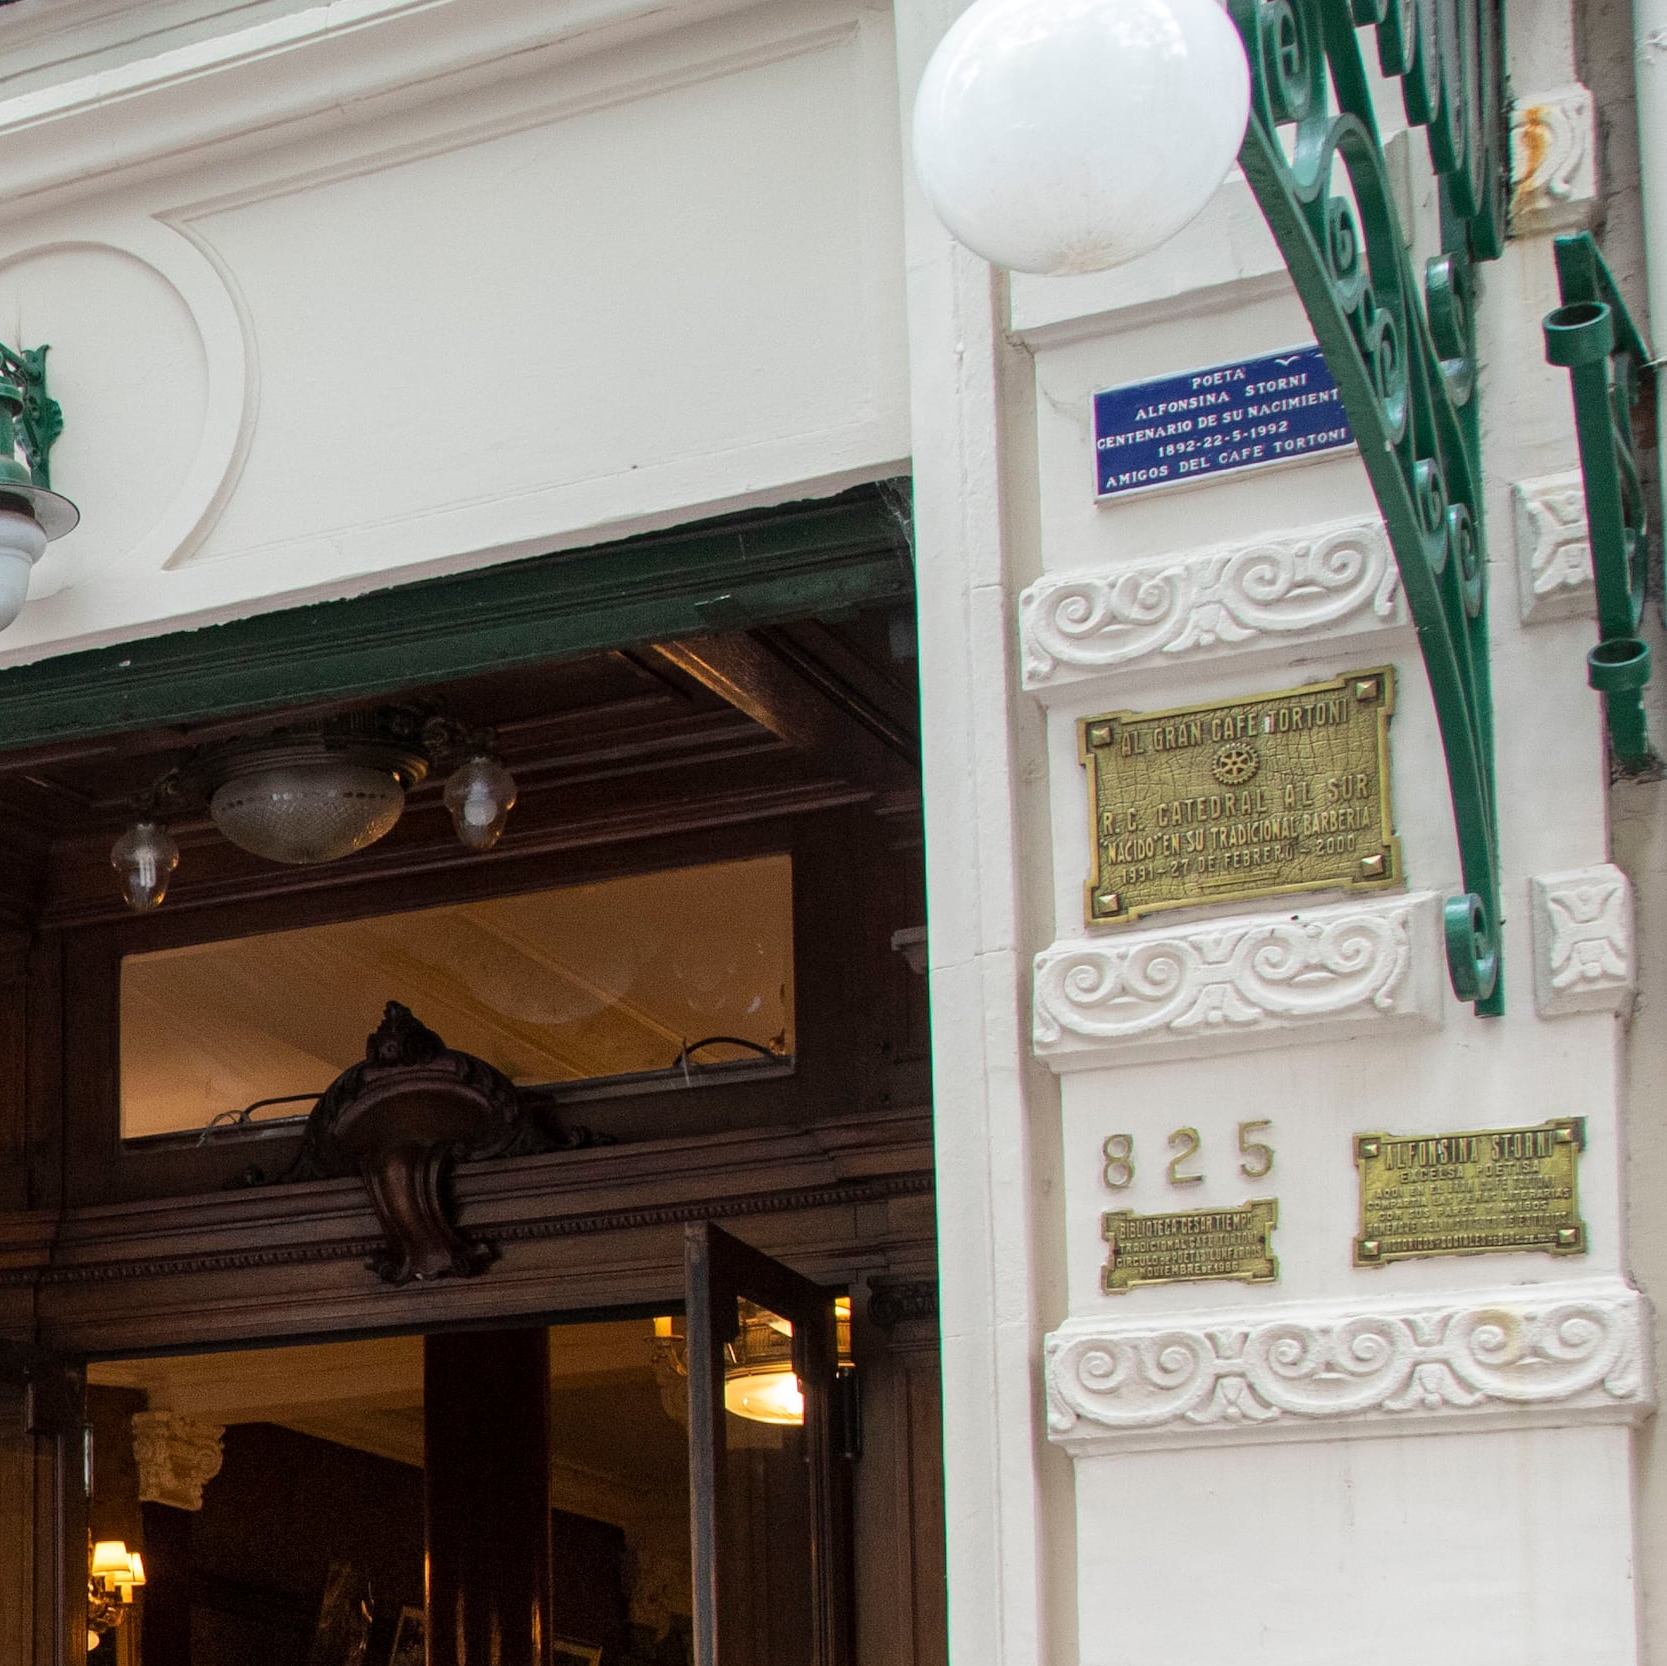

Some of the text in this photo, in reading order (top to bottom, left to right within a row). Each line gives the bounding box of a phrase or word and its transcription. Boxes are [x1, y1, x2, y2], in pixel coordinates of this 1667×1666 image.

[1135, 373, 1307, 421] ALFONSINA STORNI
[1192, 369, 1246, 389] POETA
[1097, 421, 1192, 450] CENTENARIO
[1198, 416, 1217, 428] DE
[1222, 409, 1242, 423] SU
[1106, 428, 1348, 488] AMIGOS DEL CAFE TORTONI
[1121, 699, 1348, 756] AL GRAN CAFE TORTONI
[1157, 789, 1266, 828] CATEDRAL
[1285, 781, 1313, 807] AL
[1329, 774, 1368, 801] SUR
[1163, 834, 1180, 855] EN
[1187, 831, 1205, 852] SU
[1210, 819, 1297, 849] TRADICIONAL
[1303, 807, 1370, 835] BARBERIA
[1198, 835, 1356, 872] DE FEBRERO 2000
[1385, 1131, 1553, 1170] ALFONSINA STORNI
[1401, 1160, 1540, 1184] EXCELSA POETISA
[1119, 1238, 1186, 1253] TRADICIONAL
[1189, 1235, 1214, 1248] CAFE
[1120, 1213, 1252, 1238] BIBLIOTECA CESAR TIEMPO
[1117, 1255, 1157, 1267] CIRCULO
[1172, 1250, 1205, 1263] POETAS
